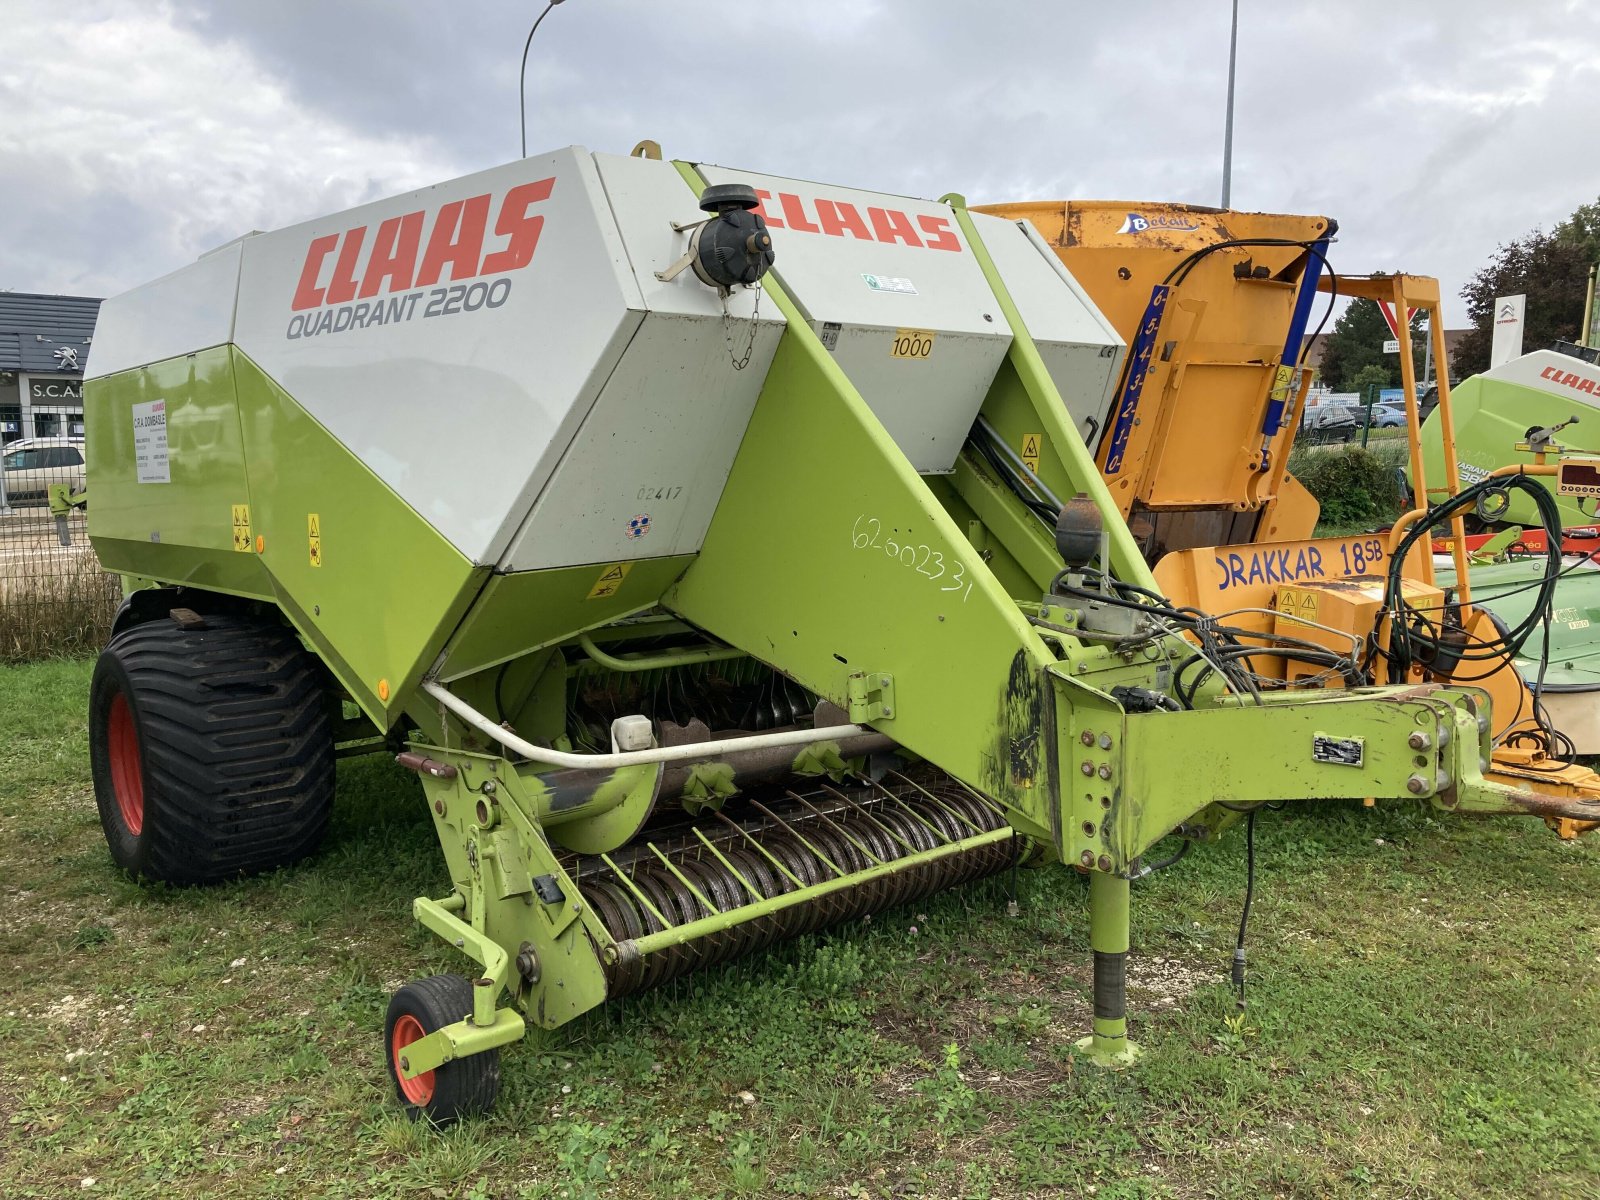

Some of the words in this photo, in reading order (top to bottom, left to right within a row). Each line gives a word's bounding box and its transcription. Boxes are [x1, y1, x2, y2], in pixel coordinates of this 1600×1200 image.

[291, 176, 556, 311] CLAAS
[752, 188, 962, 253] CLAAS
[286, 292, 424, 340] QUADRANT
[423, 278, 512, 318] 2200
[893, 337, 932, 357] 1000
[636, 486, 683, 500] 02417
[852, 514, 973, 602] 62002331
[1339, 542, 1367, 575] 18
[1365, 539, 1383, 562] SB
